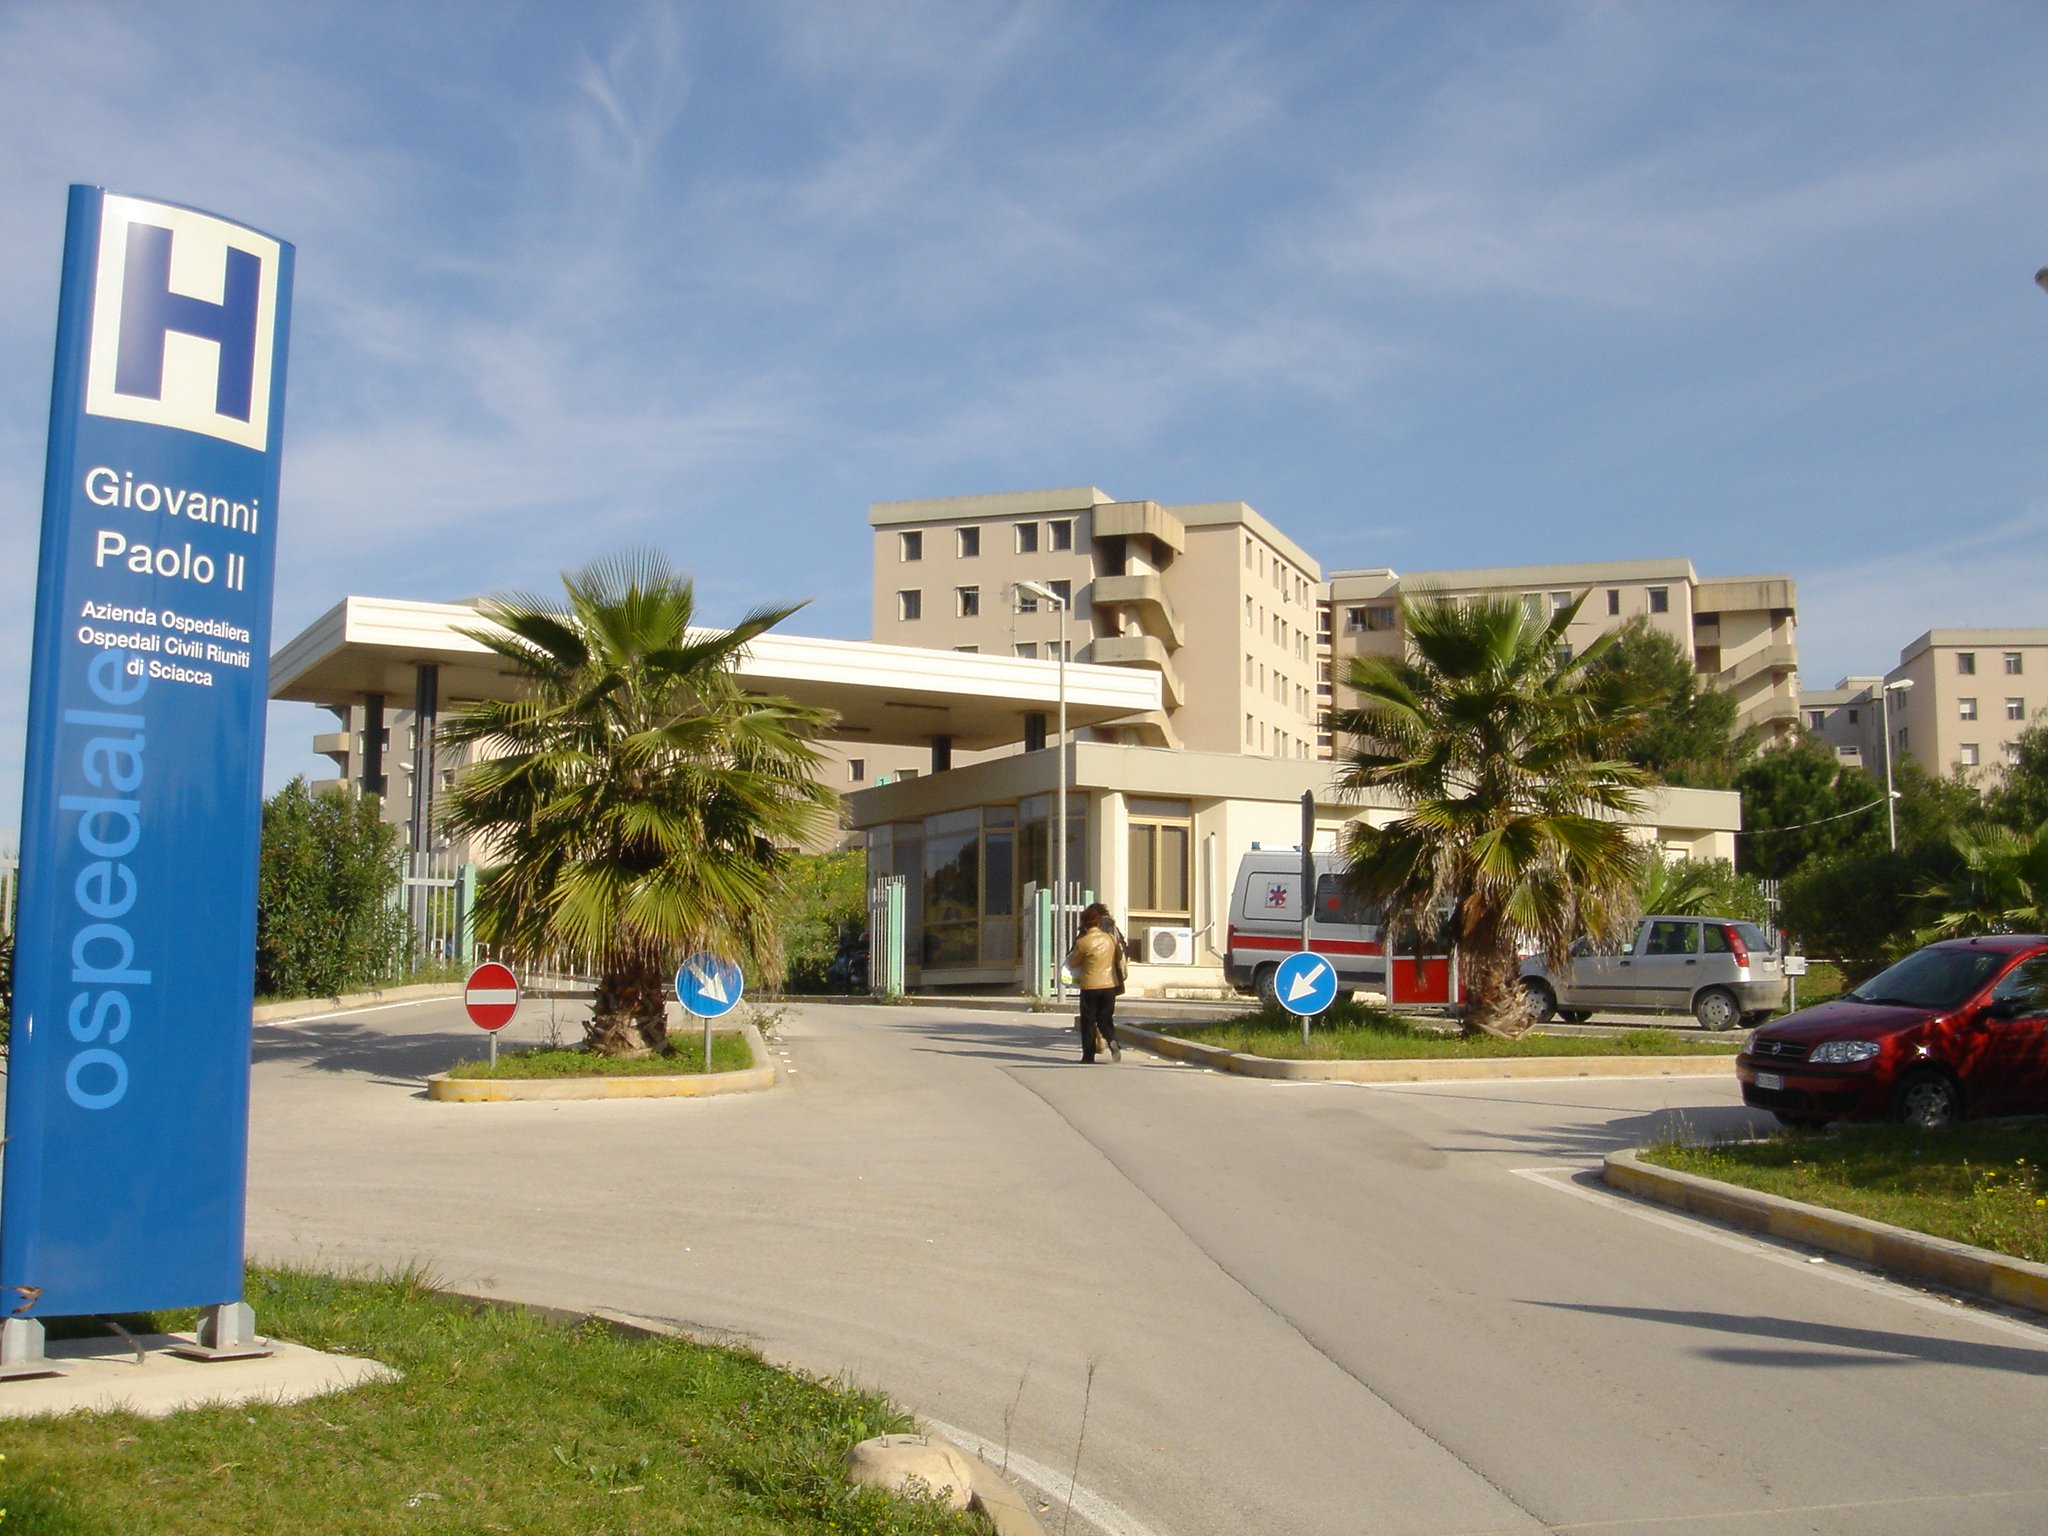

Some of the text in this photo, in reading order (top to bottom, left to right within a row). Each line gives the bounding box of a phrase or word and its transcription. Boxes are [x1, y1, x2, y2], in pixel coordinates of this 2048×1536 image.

[115, 222, 261, 424] H
[85, 467, 258, 534] Giovanni
[96, 530, 245, 592] Paolo II
[78, 626, 250, 668] Ospedali Civili Riuniti
[81, 601, 250, 643] Azienda Ospedaliera
[126, 658, 213, 687] di Sciacca
[59, 649, 152, 1110] ospedale
